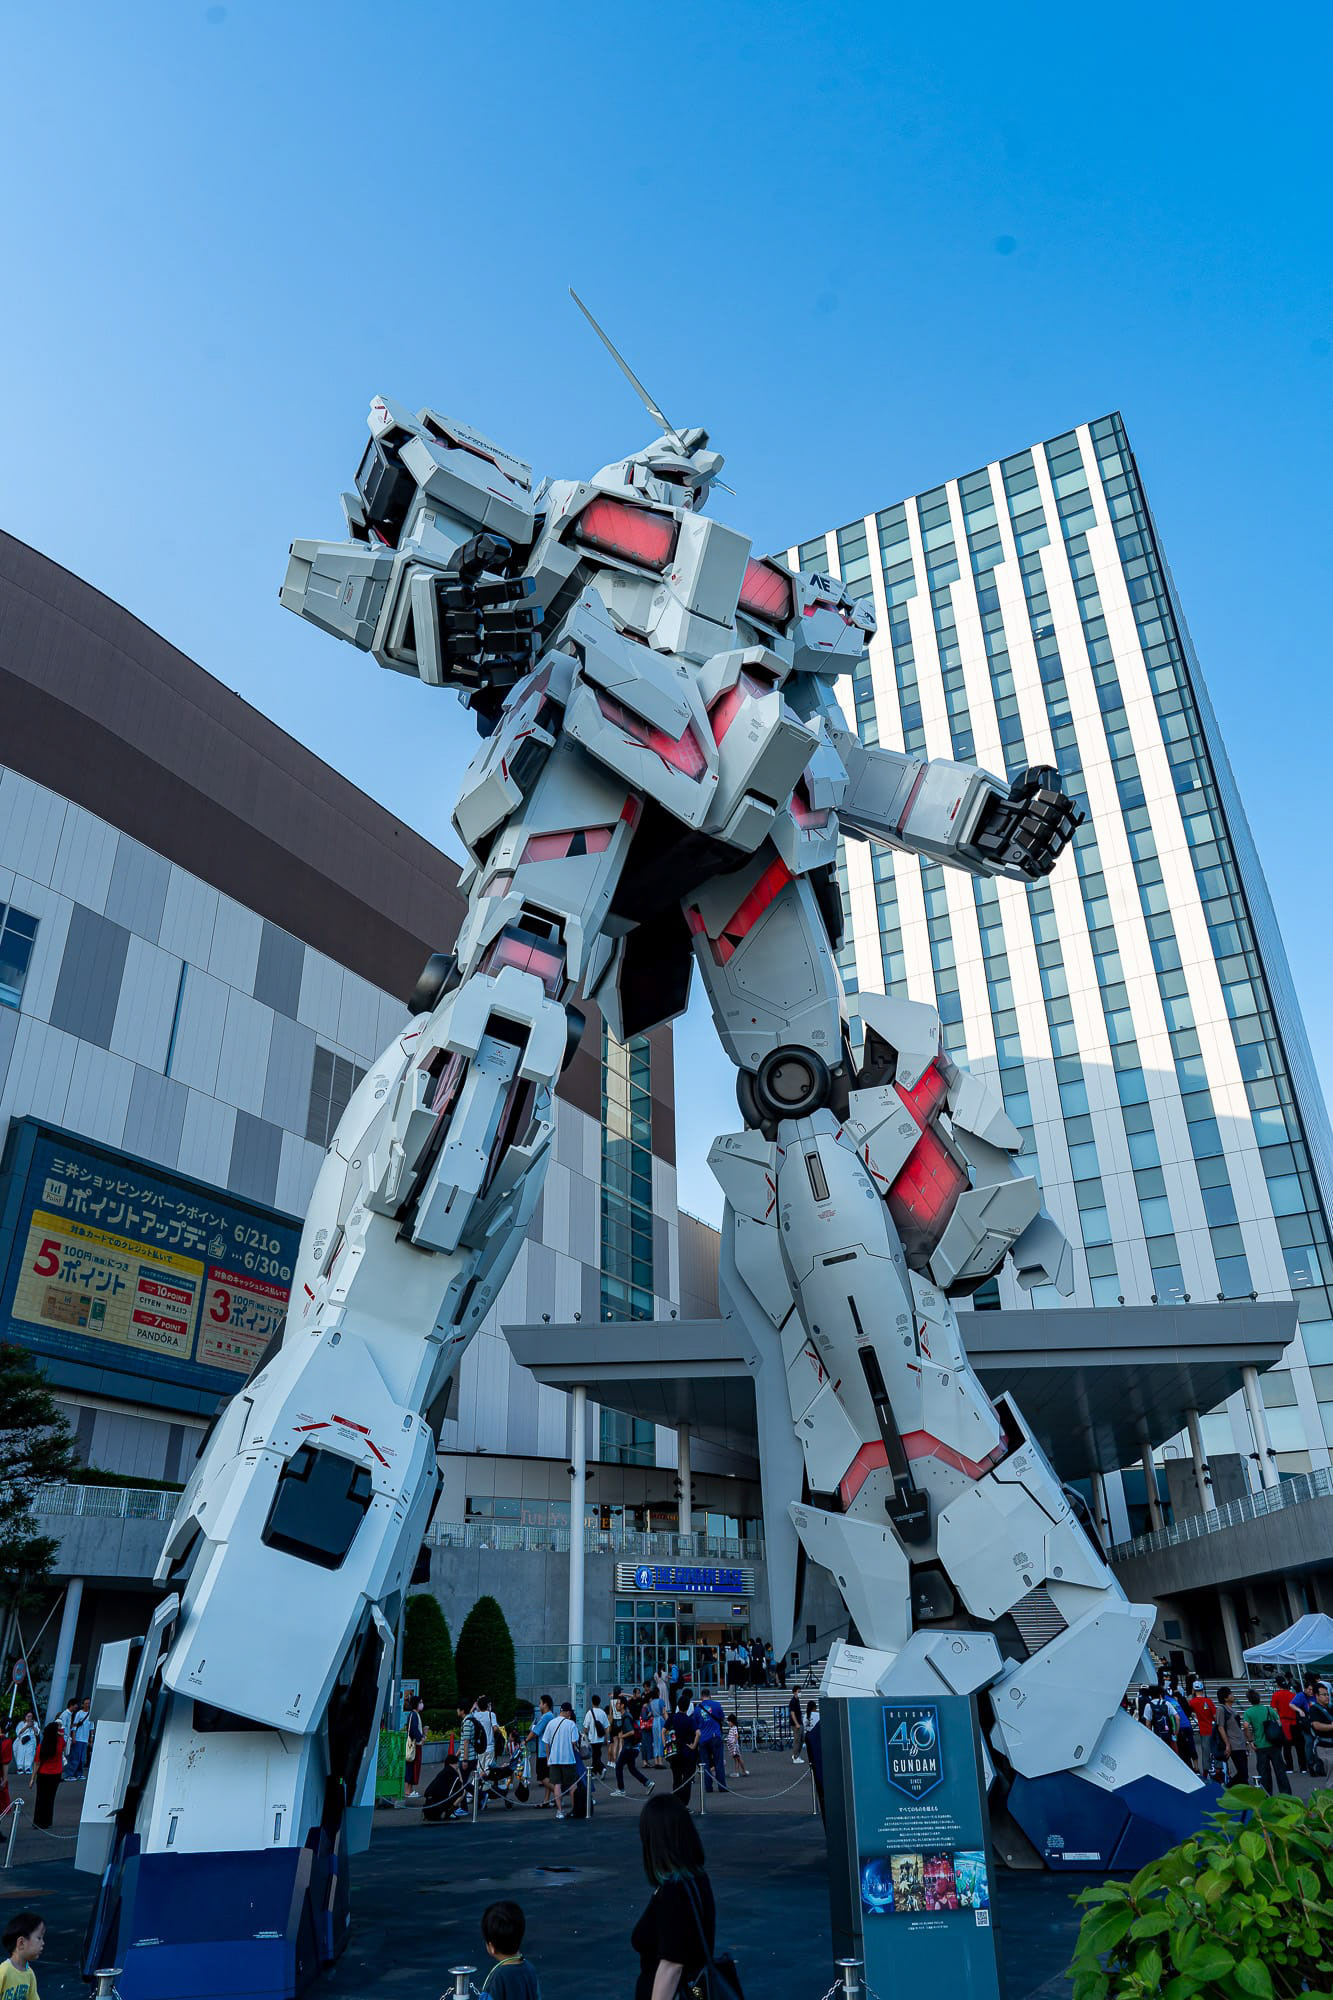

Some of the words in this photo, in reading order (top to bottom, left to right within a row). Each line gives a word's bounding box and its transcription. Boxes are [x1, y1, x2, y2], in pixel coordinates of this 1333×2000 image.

[67, 1187, 206, 1251] ポイントアップデー
[33, 1238, 62, 1277] 5
[58, 1260, 126, 1296] ポイント
[139, 1296, 162, 1308] CITEN
[209, 1289, 231, 1323] 3
[893, 1759, 937, 1772] GUNDAM
